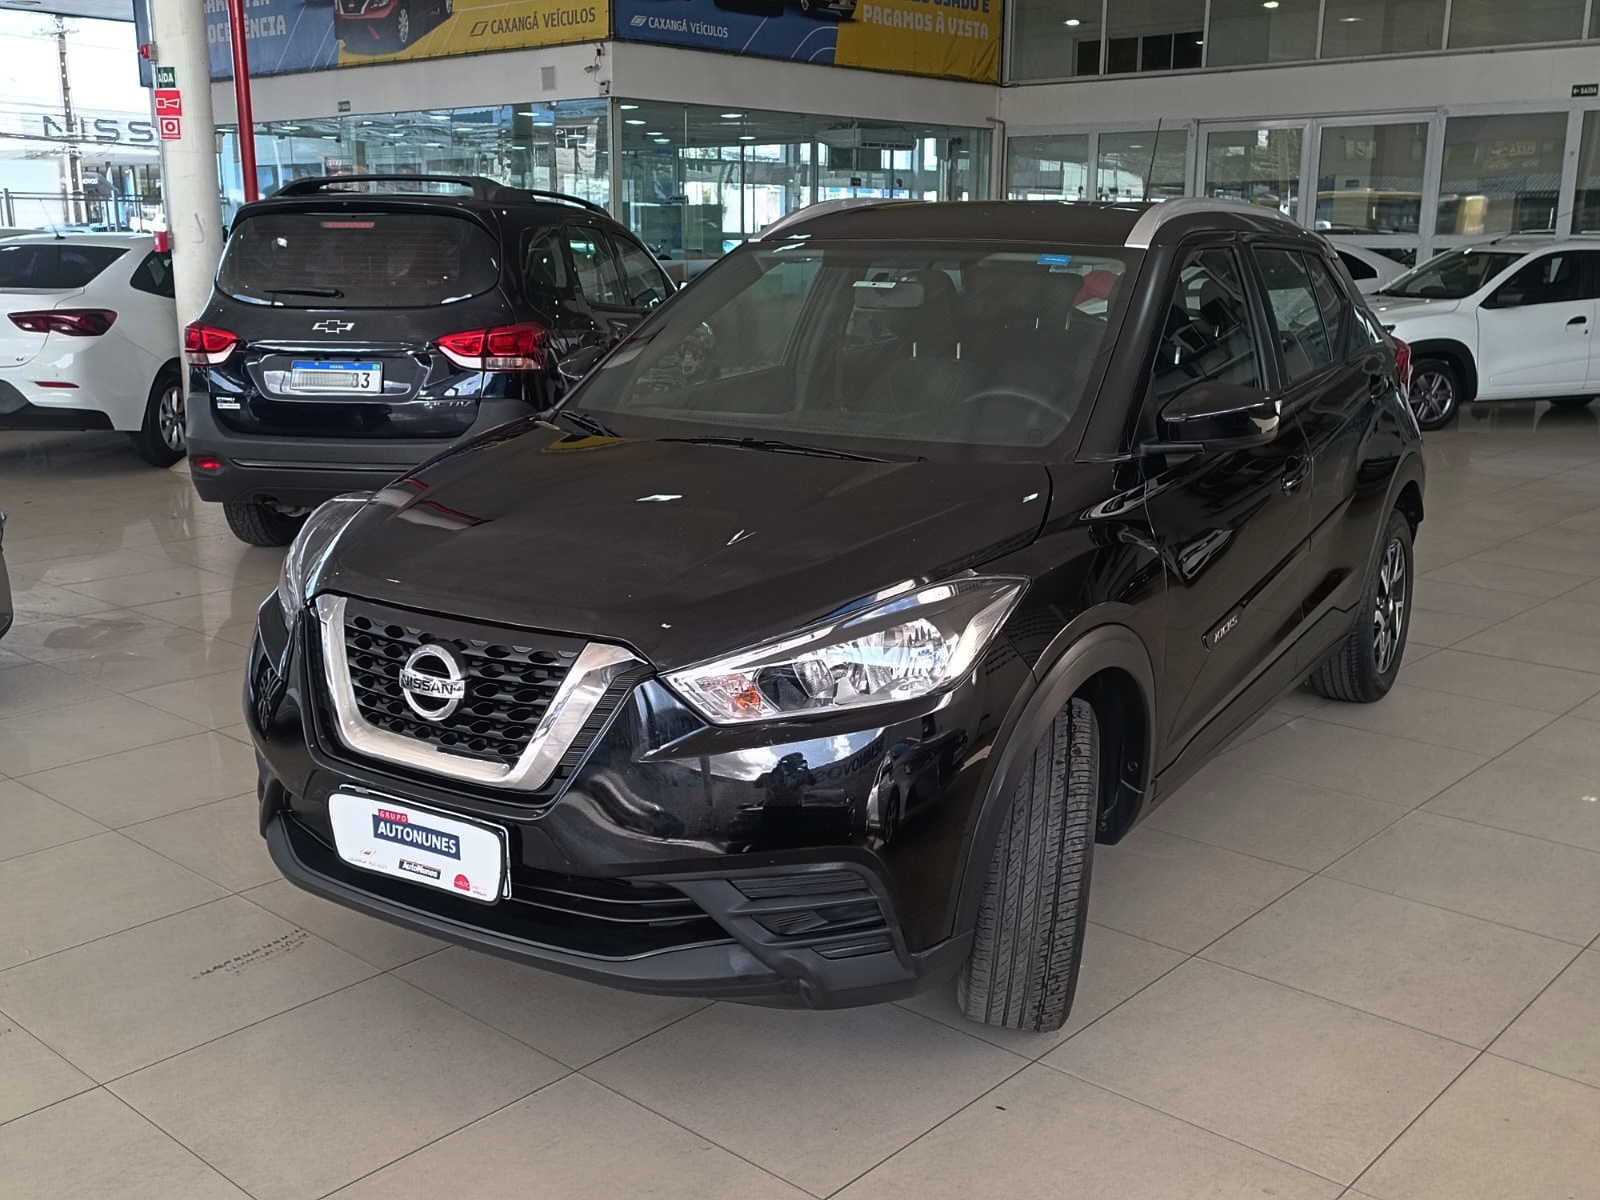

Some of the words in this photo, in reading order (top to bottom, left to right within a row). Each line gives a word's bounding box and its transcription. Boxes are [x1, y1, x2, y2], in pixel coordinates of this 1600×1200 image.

[490, 11, 539, 34] CAXANGÁ
[543, 7, 596, 28] VEÍCULOS
[648, 17, 688, 33] CAXANGÁ
[690, 21, 729, 38] VEÍCULOS
[863, 4, 932, 31] PAGAMOS
[948, 17, 989, 40] VISTA
[400, 674, 454, 695] NISSAN
[379, 810, 407, 822] GRUPO
[378, 821, 457, 854] AUTONUNES
